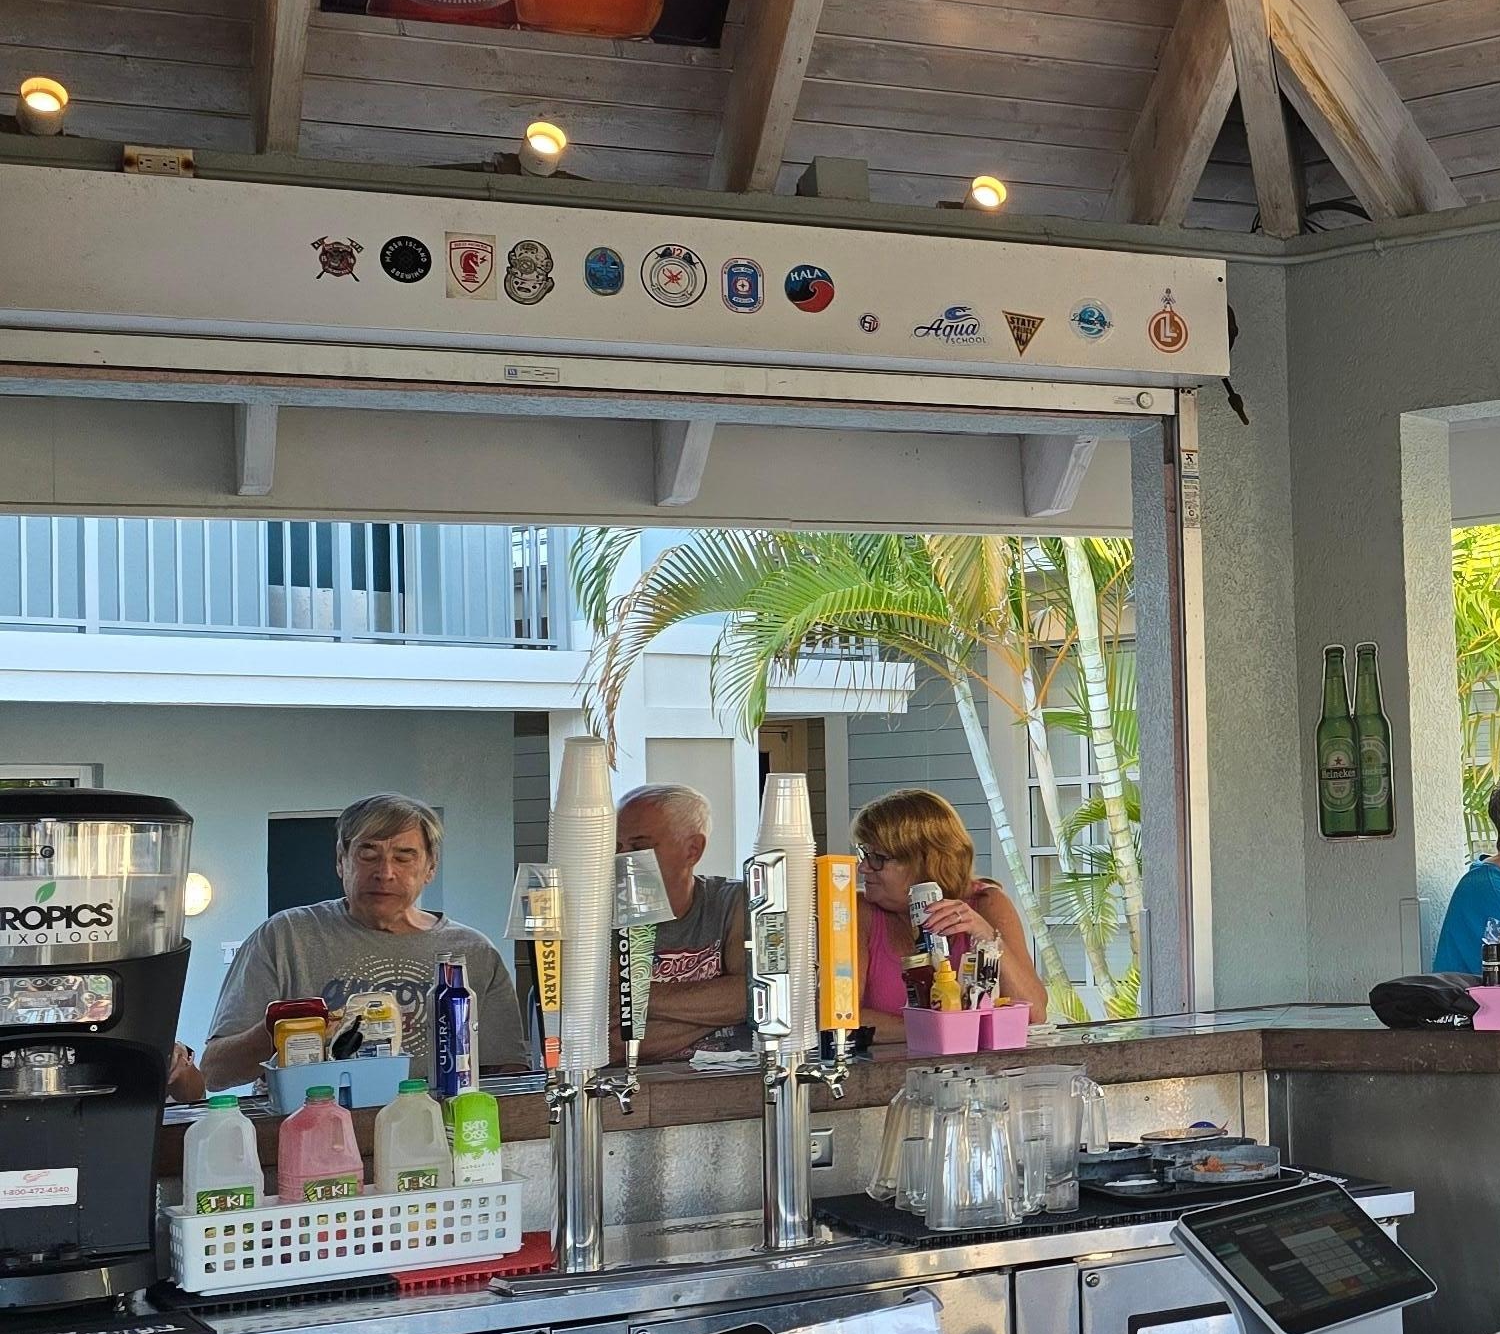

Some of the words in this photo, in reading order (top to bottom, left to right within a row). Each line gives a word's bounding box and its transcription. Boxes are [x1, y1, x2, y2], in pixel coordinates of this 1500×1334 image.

[790, 269, 822, 281] HALA
[1009, 318, 1038, 329] STATE
[914, 318, 979, 343] Aqua
[951, 336, 987, 345] SCHOOL
[1322, 768, 1356, 779] Heineken
[0, 903, 114, 931] ROPICS
[7, 930, 114, 945] IXOLOGY
